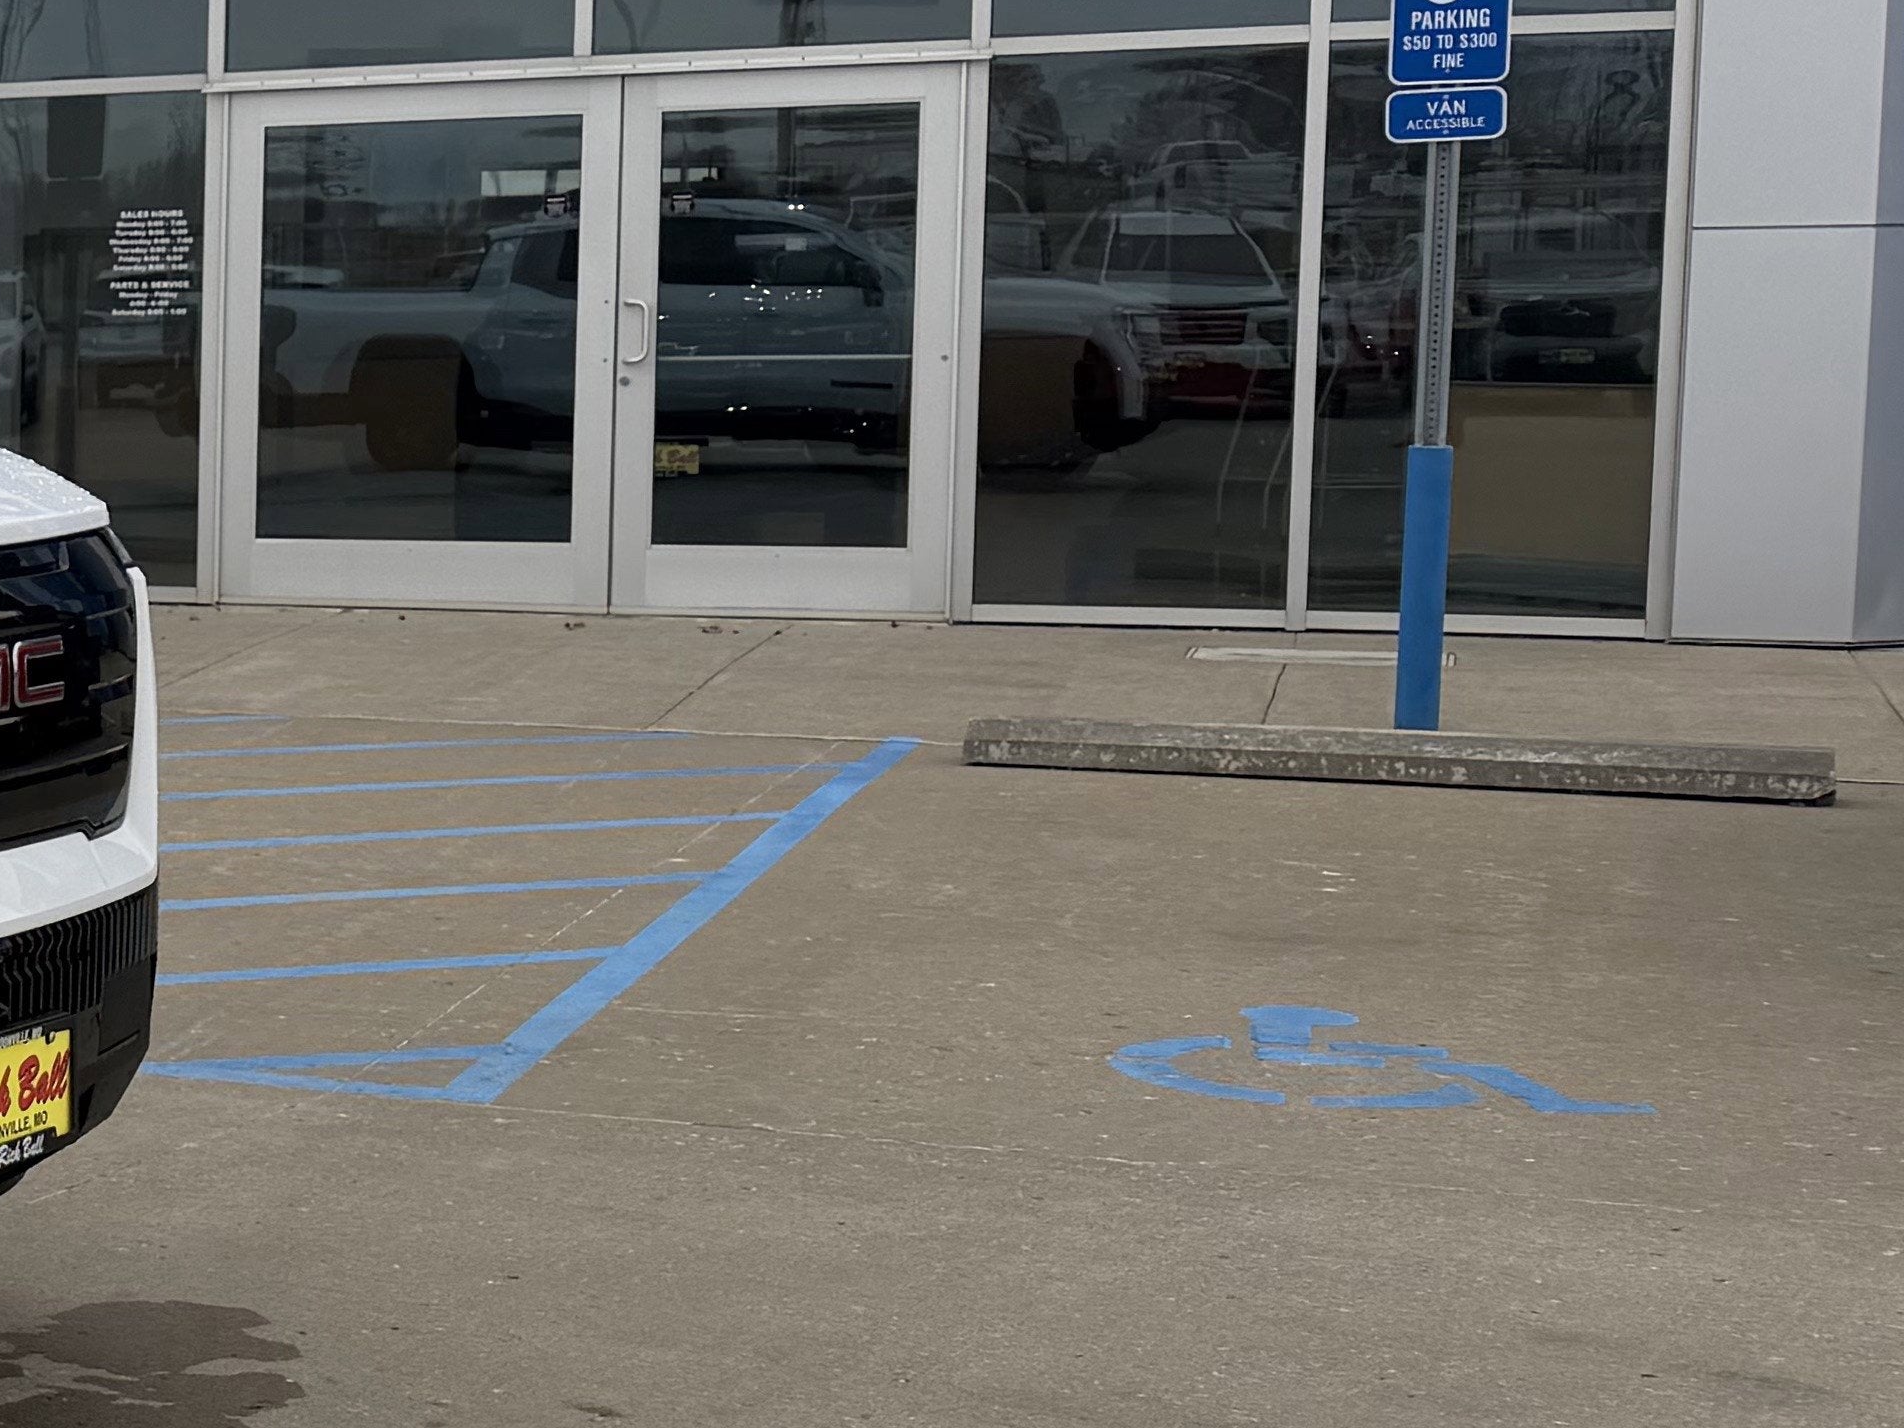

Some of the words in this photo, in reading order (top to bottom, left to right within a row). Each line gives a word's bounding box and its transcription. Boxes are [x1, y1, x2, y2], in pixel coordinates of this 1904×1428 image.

[1410, 8, 1491, 30] PARKING
[1402, 35, 1431, 51] $50
[1436, 33, 1454, 49] TO
[1459, 32, 1498, 49] $300
[1433, 53, 1465, 69] FINE
[1426, 99, 1467, 116] VAN
[1406, 116, 1486, 130] ACCESSIBLE
[18, 1047, 70, 1111] Ball
[34, 1110, 49, 1127] MO
[22, 1133, 45, 1159] Ball
